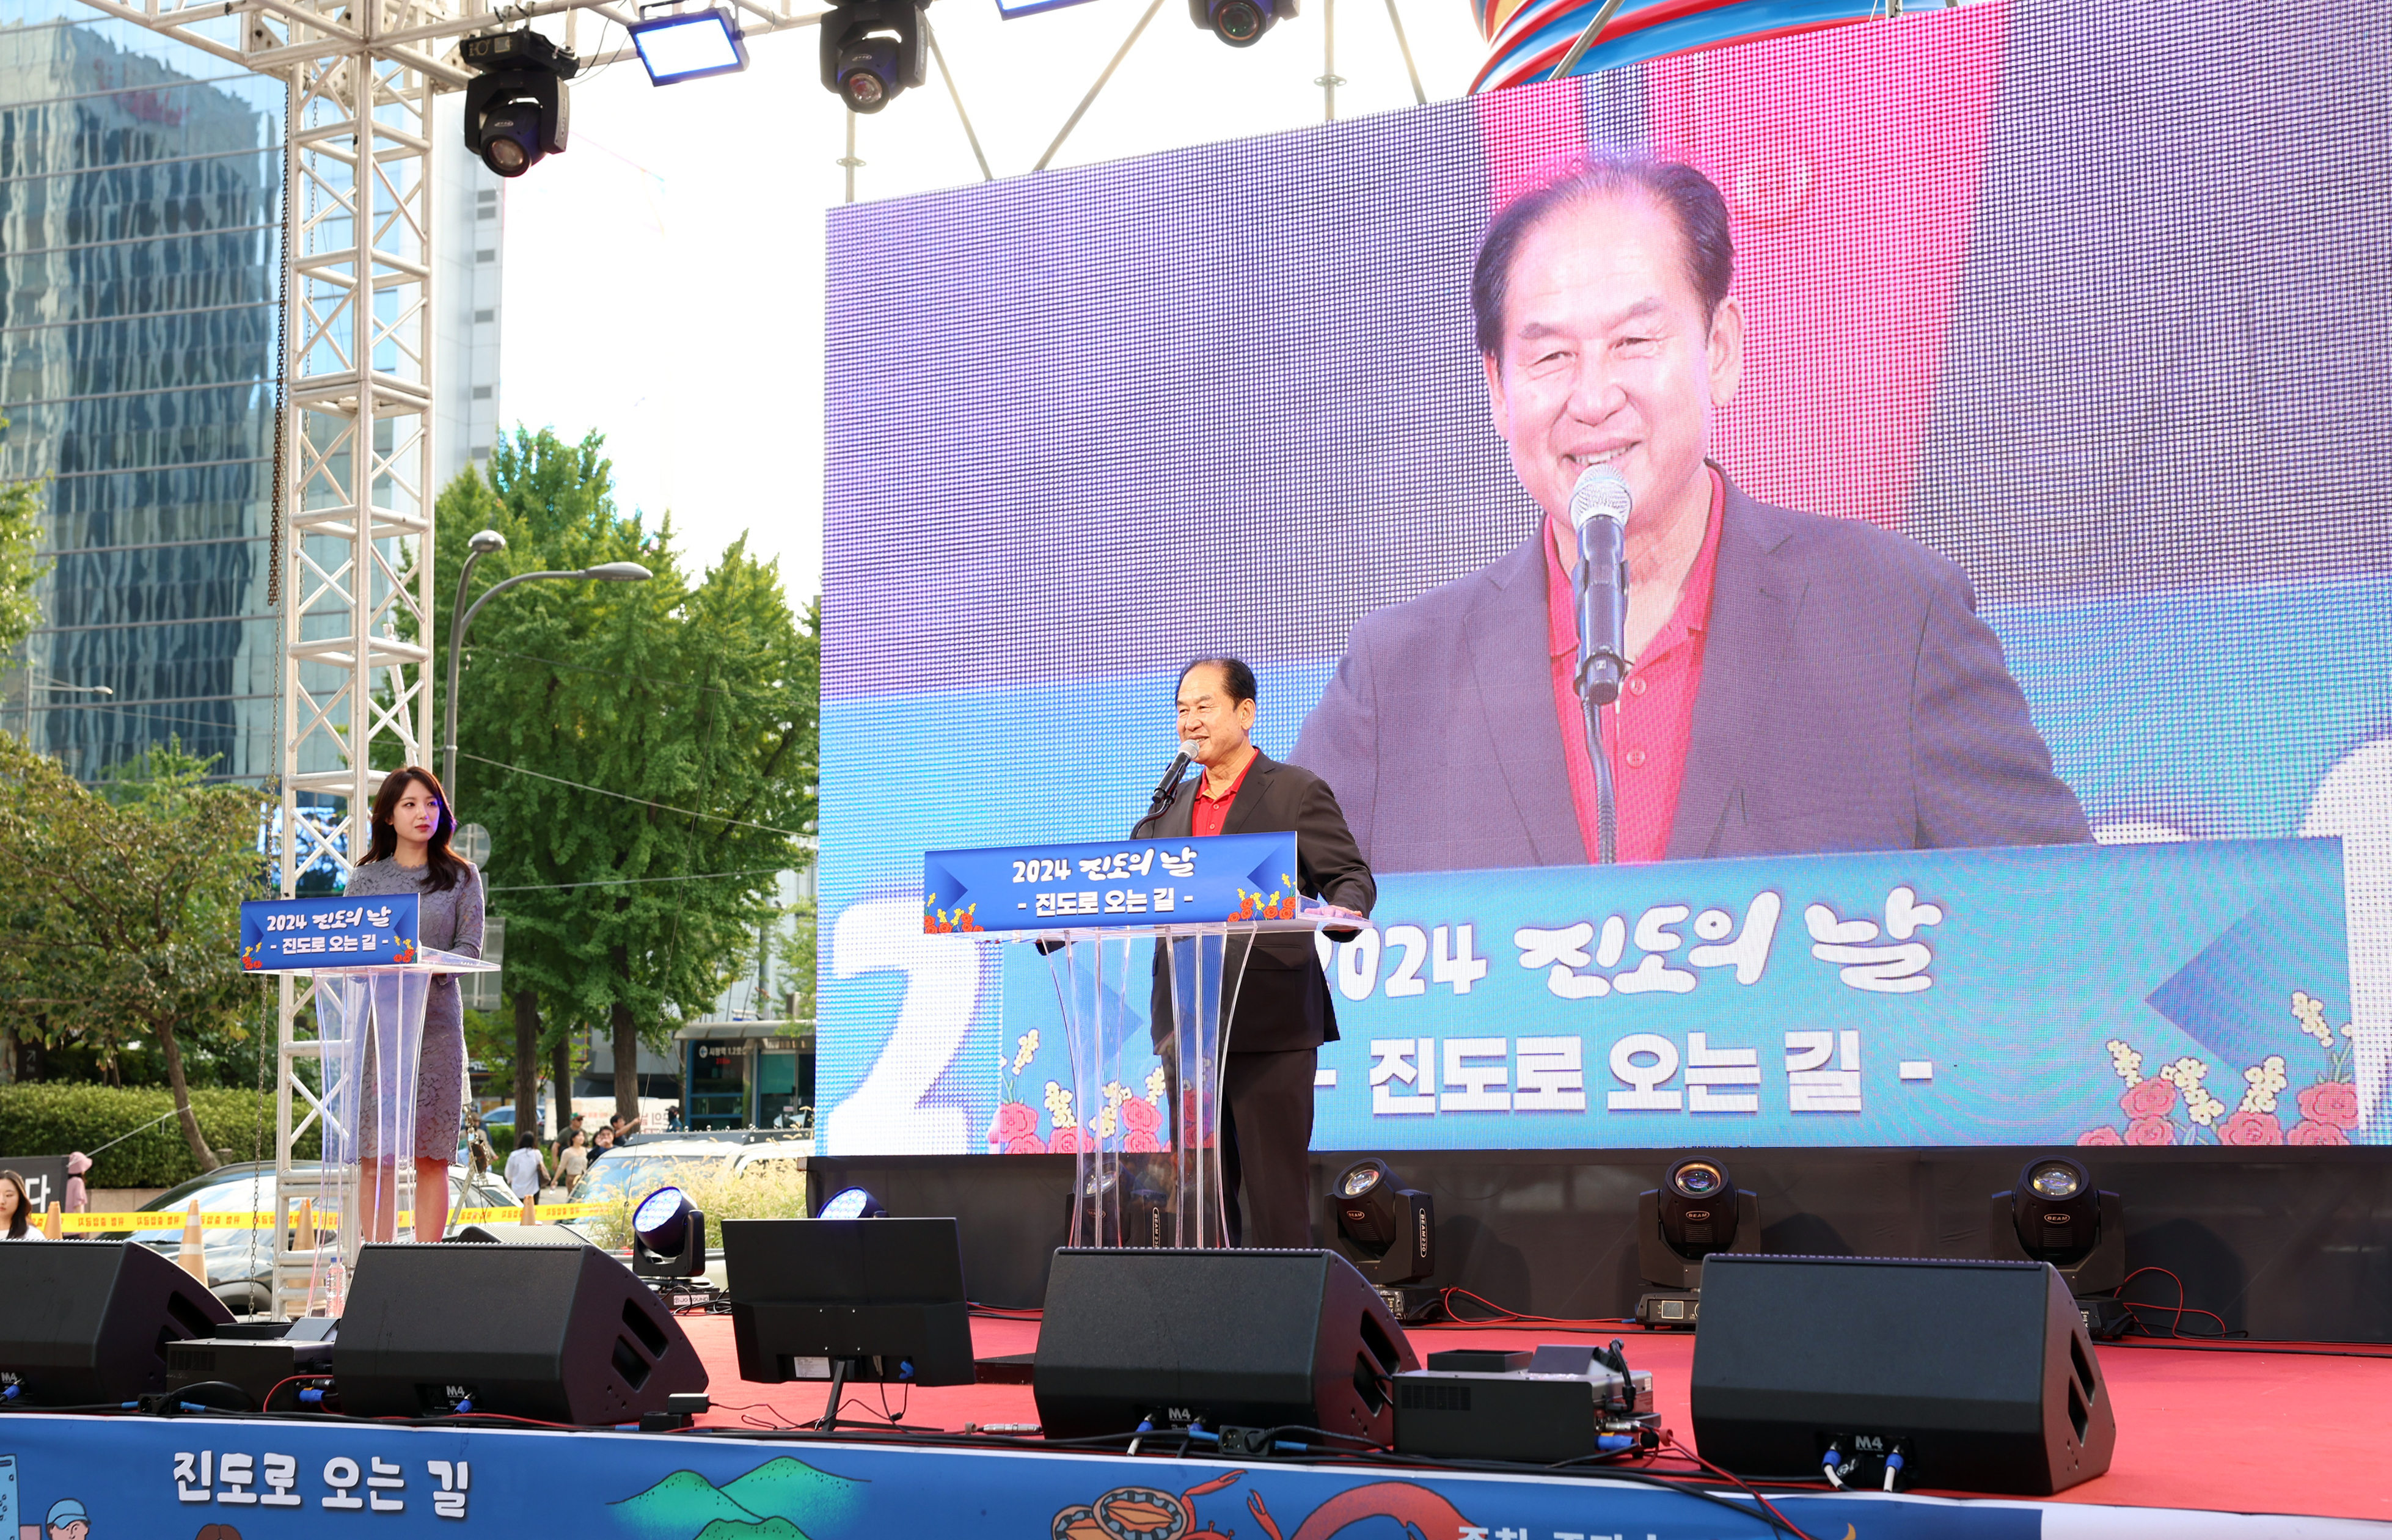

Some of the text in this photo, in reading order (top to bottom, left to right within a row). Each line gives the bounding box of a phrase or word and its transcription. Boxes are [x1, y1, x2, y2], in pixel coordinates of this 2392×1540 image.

[1012, 846, 1198, 883] 2024 진도의 날
[1035, 892, 1099, 917] 진도로
[1103, 889, 1147, 914] 오는
[1153, 888, 1175, 912] 길
[266, 906, 393, 932] 2024 진도의 날
[282, 936, 326, 955] 진도로
[329, 935, 359, 952] 오는
[362, 934, 376, 951] 길
[1518, 891, 1782, 999] 진도의
[1804, 885, 1944, 993] 날
[1369, 1037, 1586, 1115] 진도로
[1607, 1032, 1761, 1113] 오는
[1785, 1029, 1862, 1113] 길
[1, 1371, 18, 1382] M4
[446, 1385, 466, 1396] M4
[1168, 1407, 1191, 1420] M4
[1855, 1436, 1883, 1449] M4
[172, 1450, 469, 1519] 진도로 오는 길
